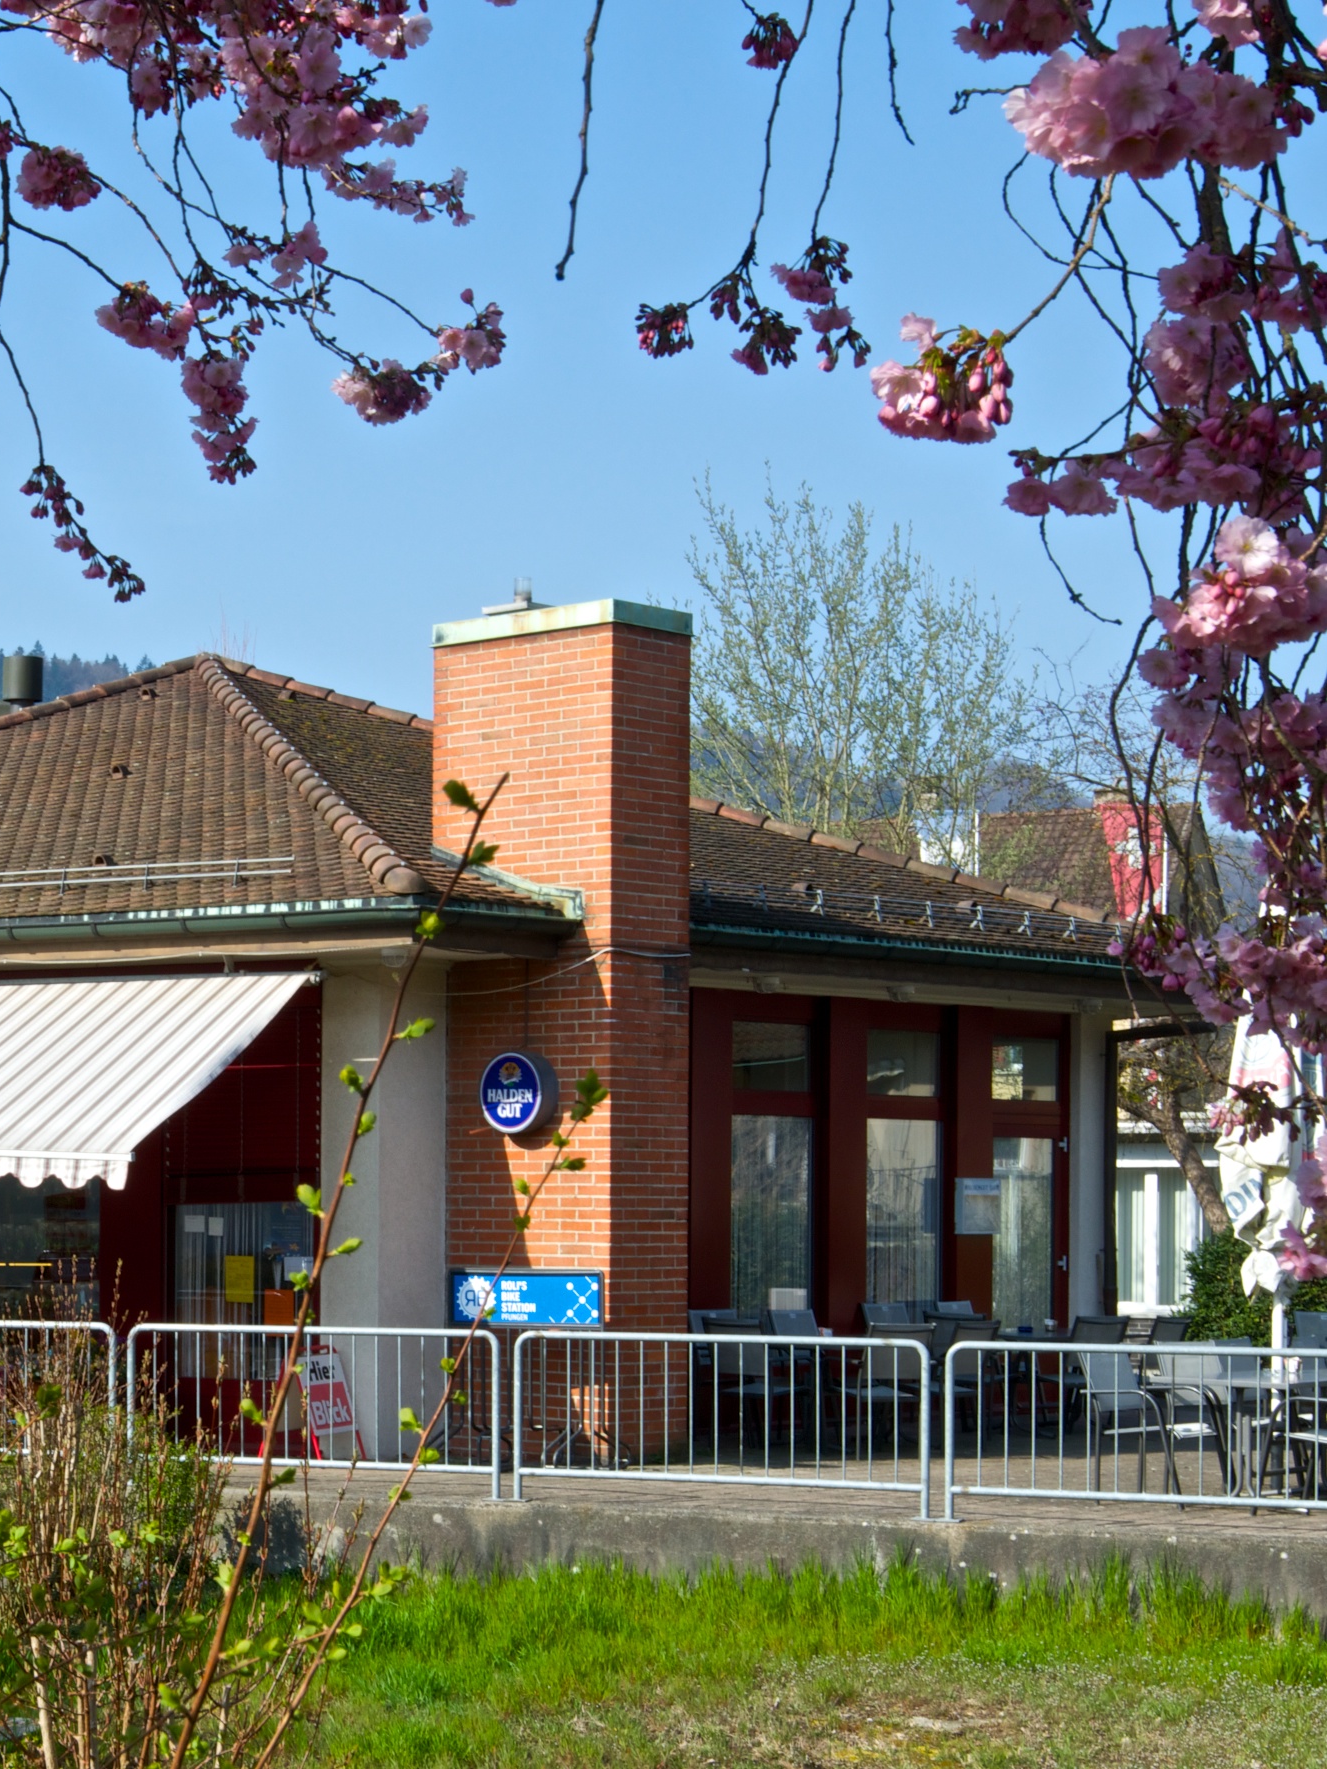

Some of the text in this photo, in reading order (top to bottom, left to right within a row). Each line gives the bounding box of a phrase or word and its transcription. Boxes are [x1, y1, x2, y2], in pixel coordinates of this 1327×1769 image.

[487, 1089, 533, 1103] HALDEN
[497, 1103, 523, 1118] GUT
[501, 1281, 527, 1291] ROLI'S
[501, 1292, 520, 1302] BIKE
[501, 1302, 536, 1313] STATION
[501, 1313, 528, 1321] PFUNGEN
[305, 1361, 335, 1382] Hier
[311, 1398, 351, 1425] Blick
